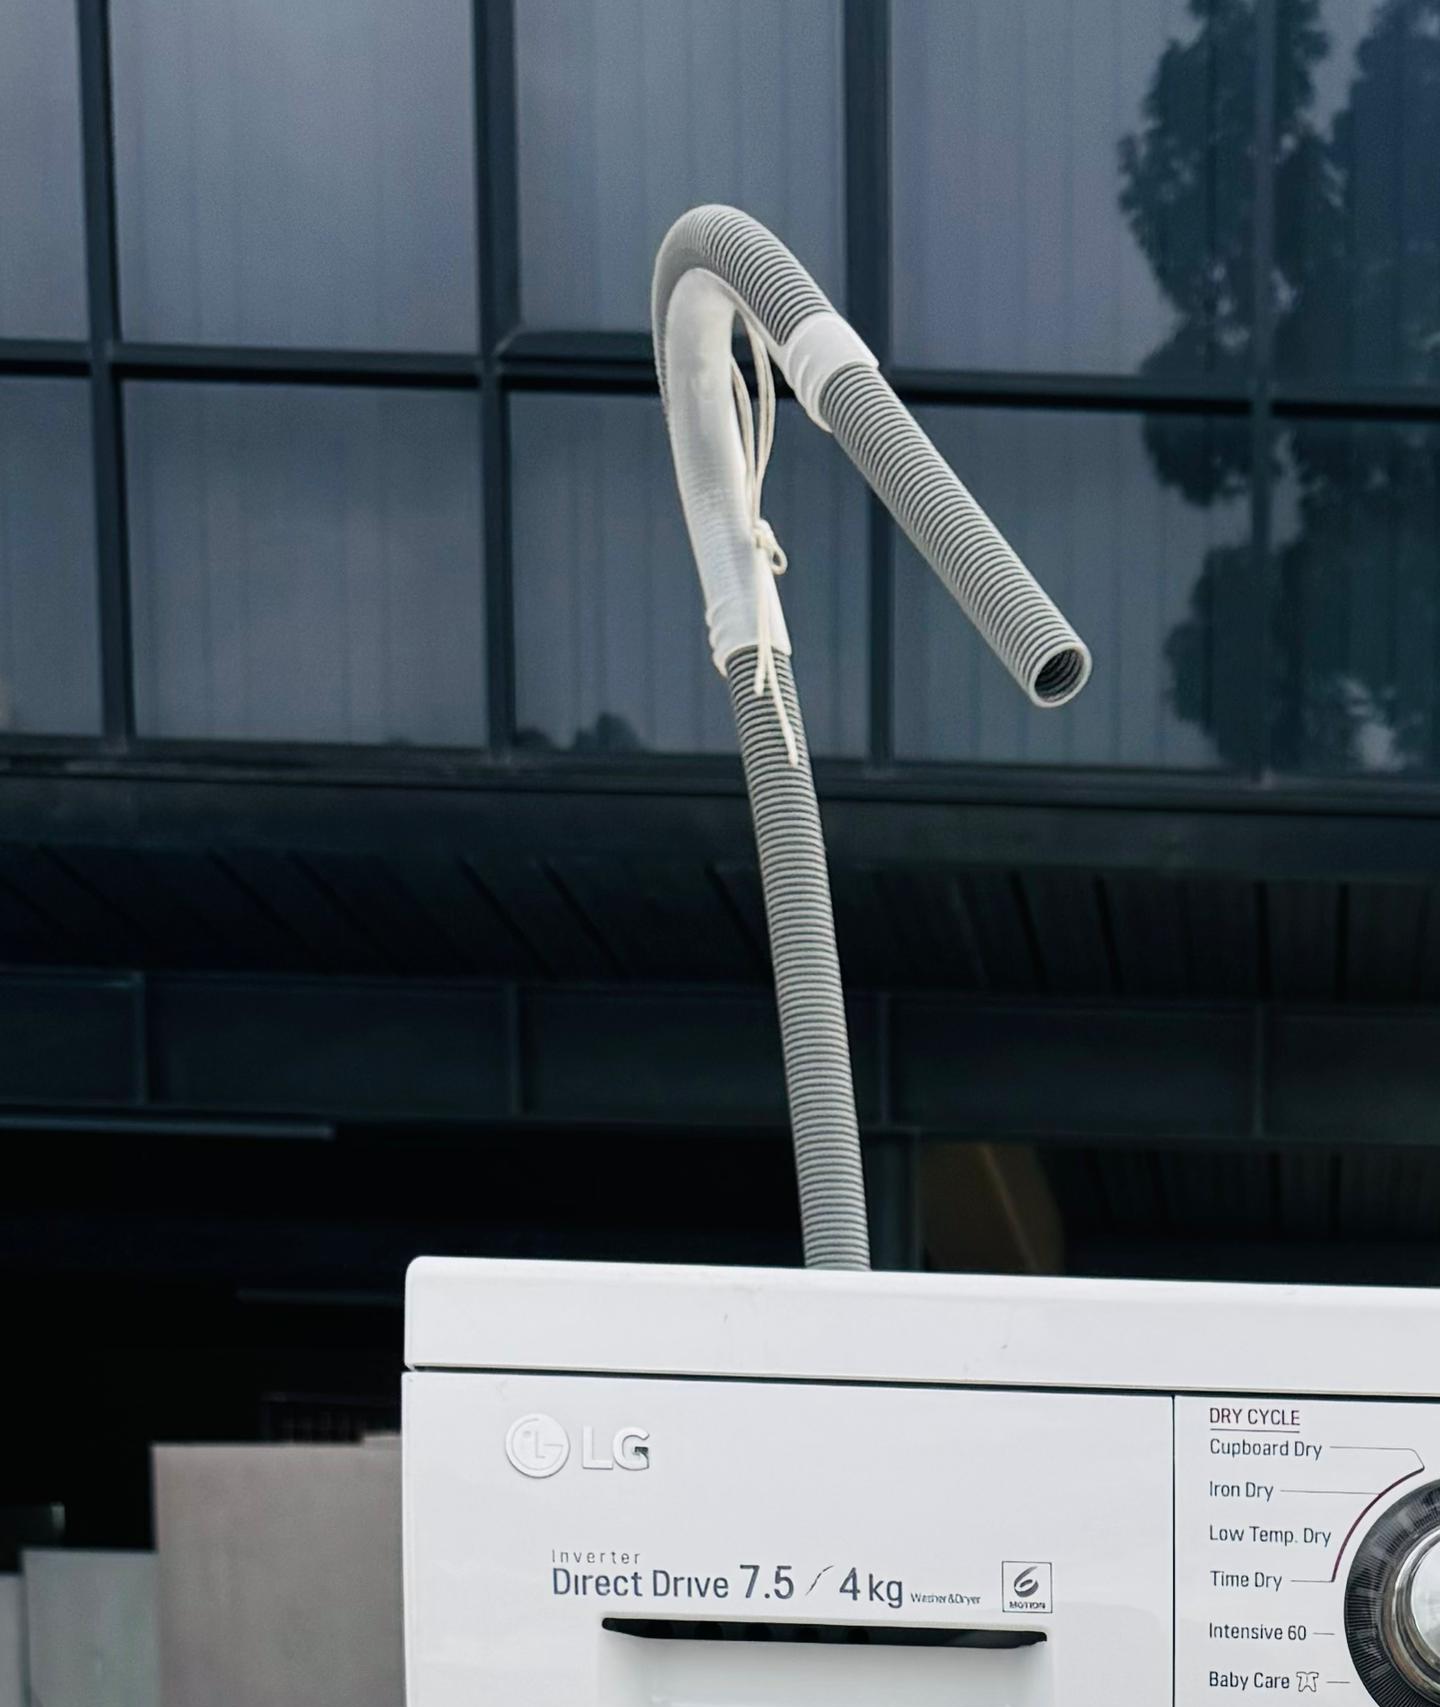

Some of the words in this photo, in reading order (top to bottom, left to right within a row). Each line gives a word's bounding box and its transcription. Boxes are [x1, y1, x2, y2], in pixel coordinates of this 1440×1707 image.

[1209, 1408, 1242, 1425] DRY
[1247, 1409, 1300, 1426] CYCLE
[582, 1425, 650, 1471] LG
[1210, 1440, 1288, 1458] Cupboard
[1294, 1442, 1322, 1460] Dry
[1209, 1482, 1240, 1498] Iron
[1245, 1483, 1274, 1501] Dry
[1209, 1526, 1244, 1543] Low
[1249, 1528, 1299, 1547] Temp.
[1303, 1528, 1331, 1547] Dry
[552, 1549, 641, 1564] Inverter
[553, 1567, 642, 1598] Direct
[653, 1570, 729, 1599] Drive
[740, 1565, 794, 1600] 7.5
[1210, 1571, 1248, 1587] Time
[1254, 1572, 1282, 1591] Dry
[1009, 1601, 1045, 1610] MOTION
[1209, 1624, 1283, 1640] Intensive
[1287, 1625, 1306, 1641] 60
[1209, 1672, 1248, 1691] Baby
[1253, 1673, 1290, 1689] Care
